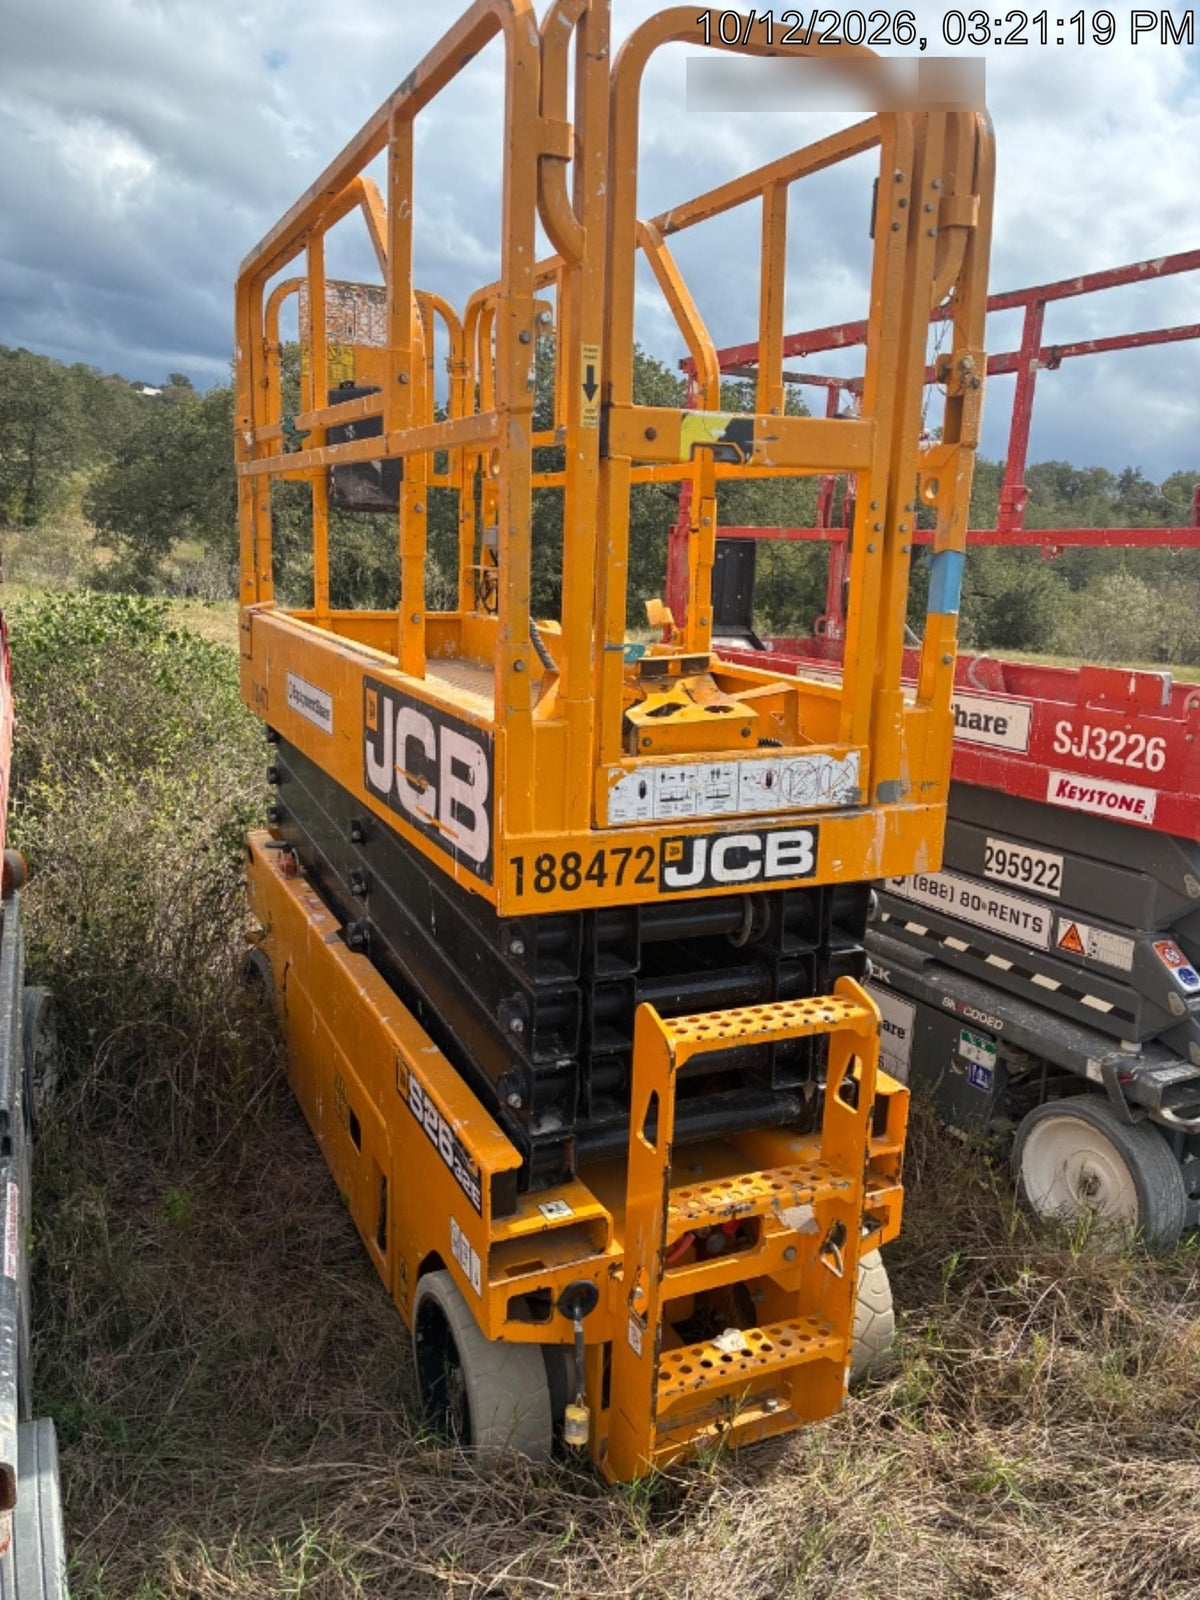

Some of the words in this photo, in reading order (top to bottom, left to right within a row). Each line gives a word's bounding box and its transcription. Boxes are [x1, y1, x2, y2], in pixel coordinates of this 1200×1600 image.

[951, 703, 1008, 736] hare
[1053, 720, 1166, 772] SJ3226
[366, 696, 490, 863] JCB
[1055, 778, 1145, 814] KEYSTONE
[509, 845, 655, 897] 188472
[664, 829, 814, 888] JCB
[984, 845, 1061, 891] 295922
[913, 874, 954, 903] (888)
